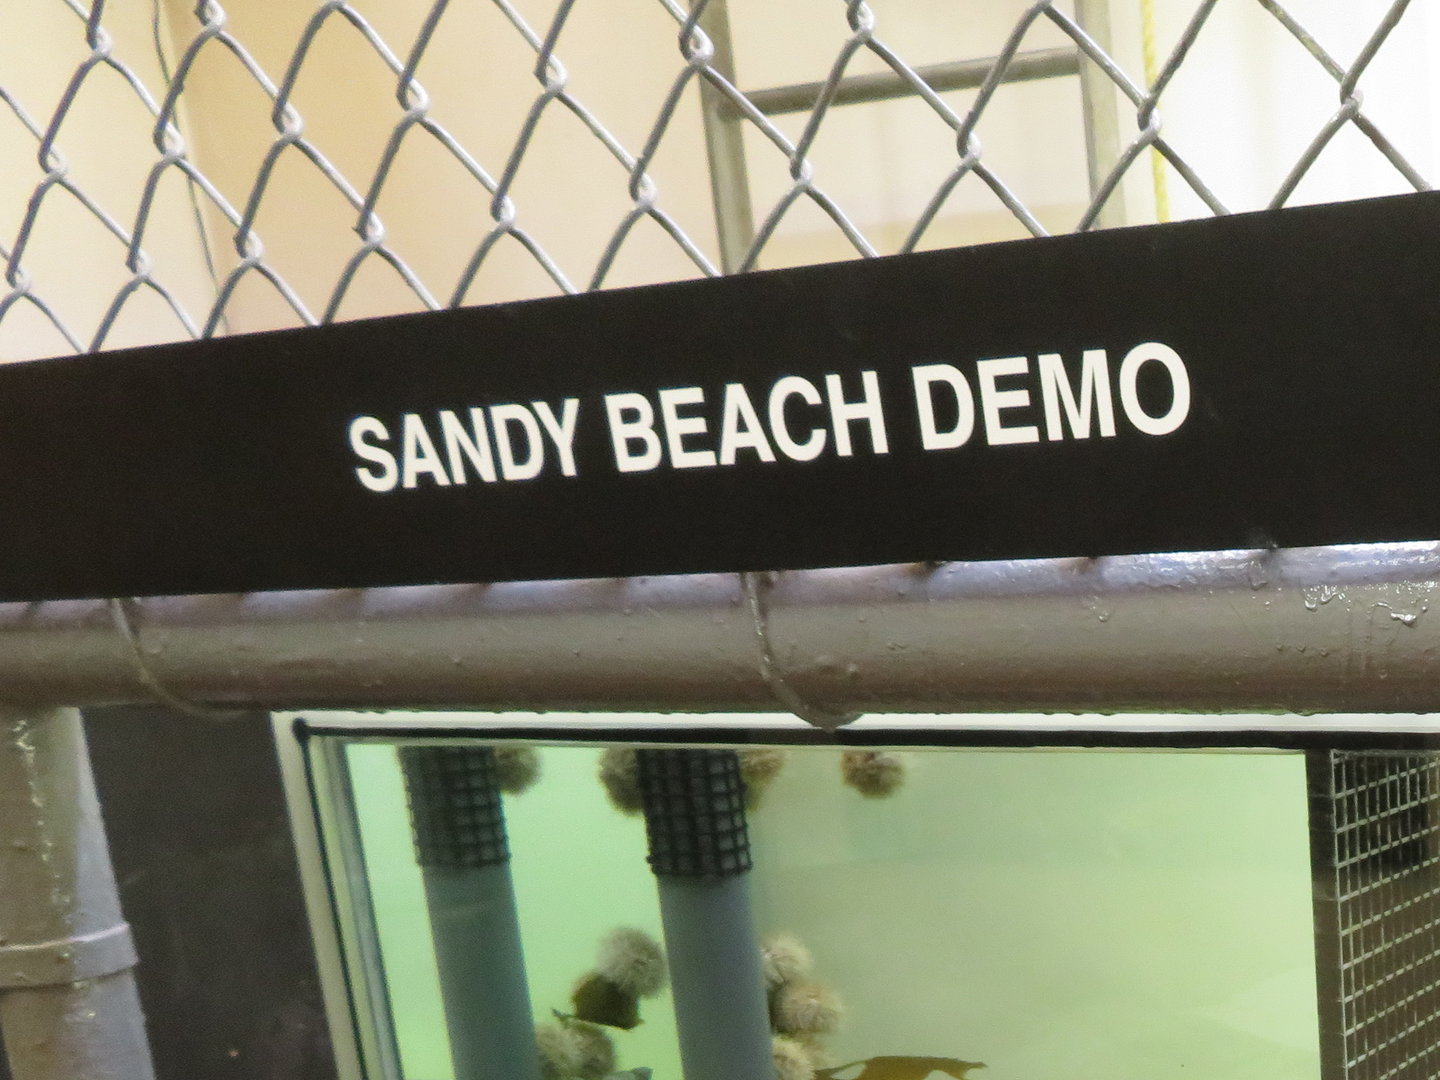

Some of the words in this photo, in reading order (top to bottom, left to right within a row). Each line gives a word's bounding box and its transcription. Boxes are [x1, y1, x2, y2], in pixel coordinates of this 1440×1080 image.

[348, 398, 580, 493] SANDY
[604, 370, 889, 473] BEACH
[911, 342, 1191, 451] DEMO
